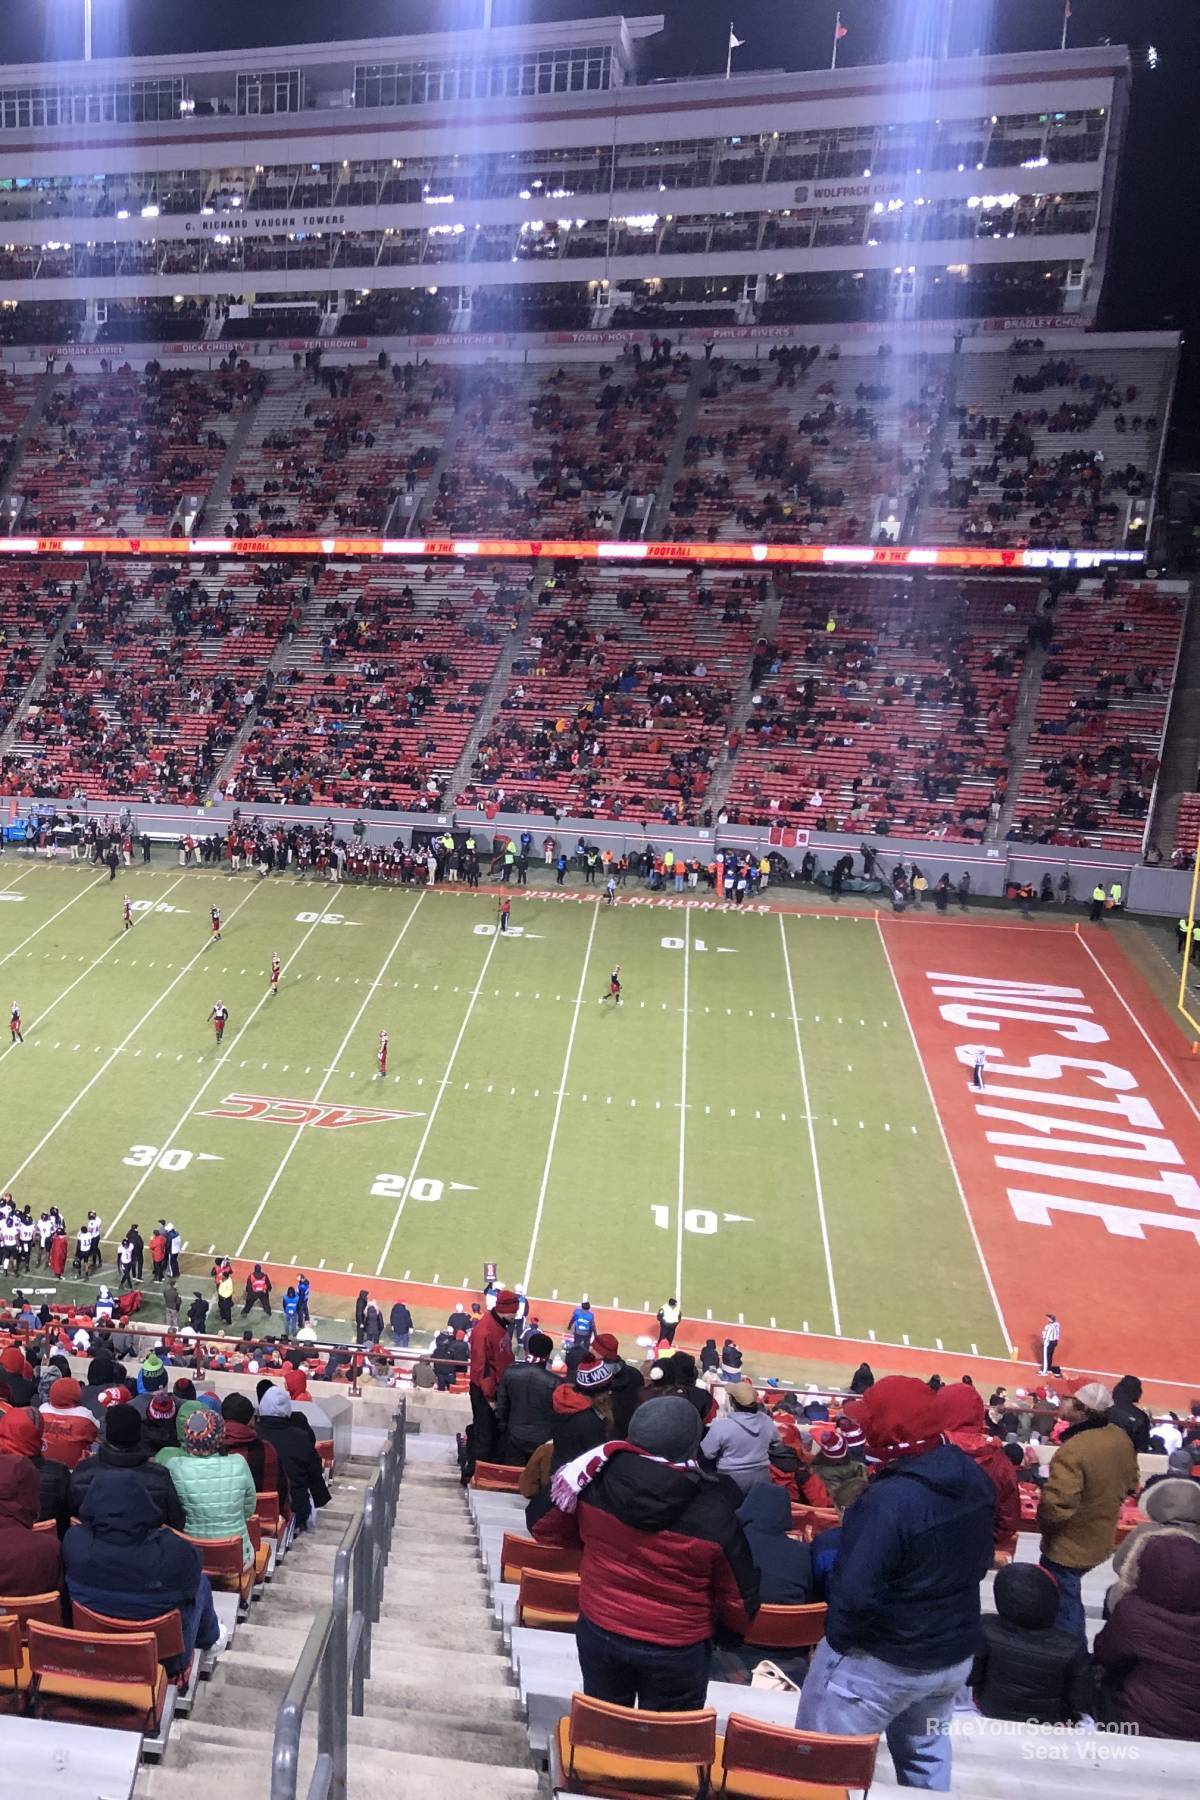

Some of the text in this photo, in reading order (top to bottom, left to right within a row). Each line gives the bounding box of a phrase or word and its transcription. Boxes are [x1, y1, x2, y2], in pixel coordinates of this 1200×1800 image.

[813, 184, 870, 199] WOLFPACK
[202, 219, 248, 230] RICHARD
[255, 217, 296, 228] VAUGHN
[302, 214, 346, 225] TOWERS
[1003, 319, 1051, 329] BRADLEY
[712, 327, 790, 338] PHILIP RIVERS
[182, 342, 246, 352] DICK CHRISTY
[324, 339, 358, 348] BROWN
[38, 542, 63, 550] IN THE
[233, 542, 271, 551] FOOTBALL
[426, 543, 453, 553] IN THE
[649, 545, 692, 556] FOOTBALL
[874, 551, 908, 560] IN THE
[520, 889, 581, 901] PACK
[628, 896, 657, 906] IN
[294, 911, 346, 926] 30
[660, 936, 709, 951] 10
[194, 1092, 428, 1130] ACC
[926, 971, 1200, 1247] NC STATE
[122, 1144, 194, 1172] 30
[369, 1172, 445, 1202] 20
[650, 1203, 718, 1235] 10
